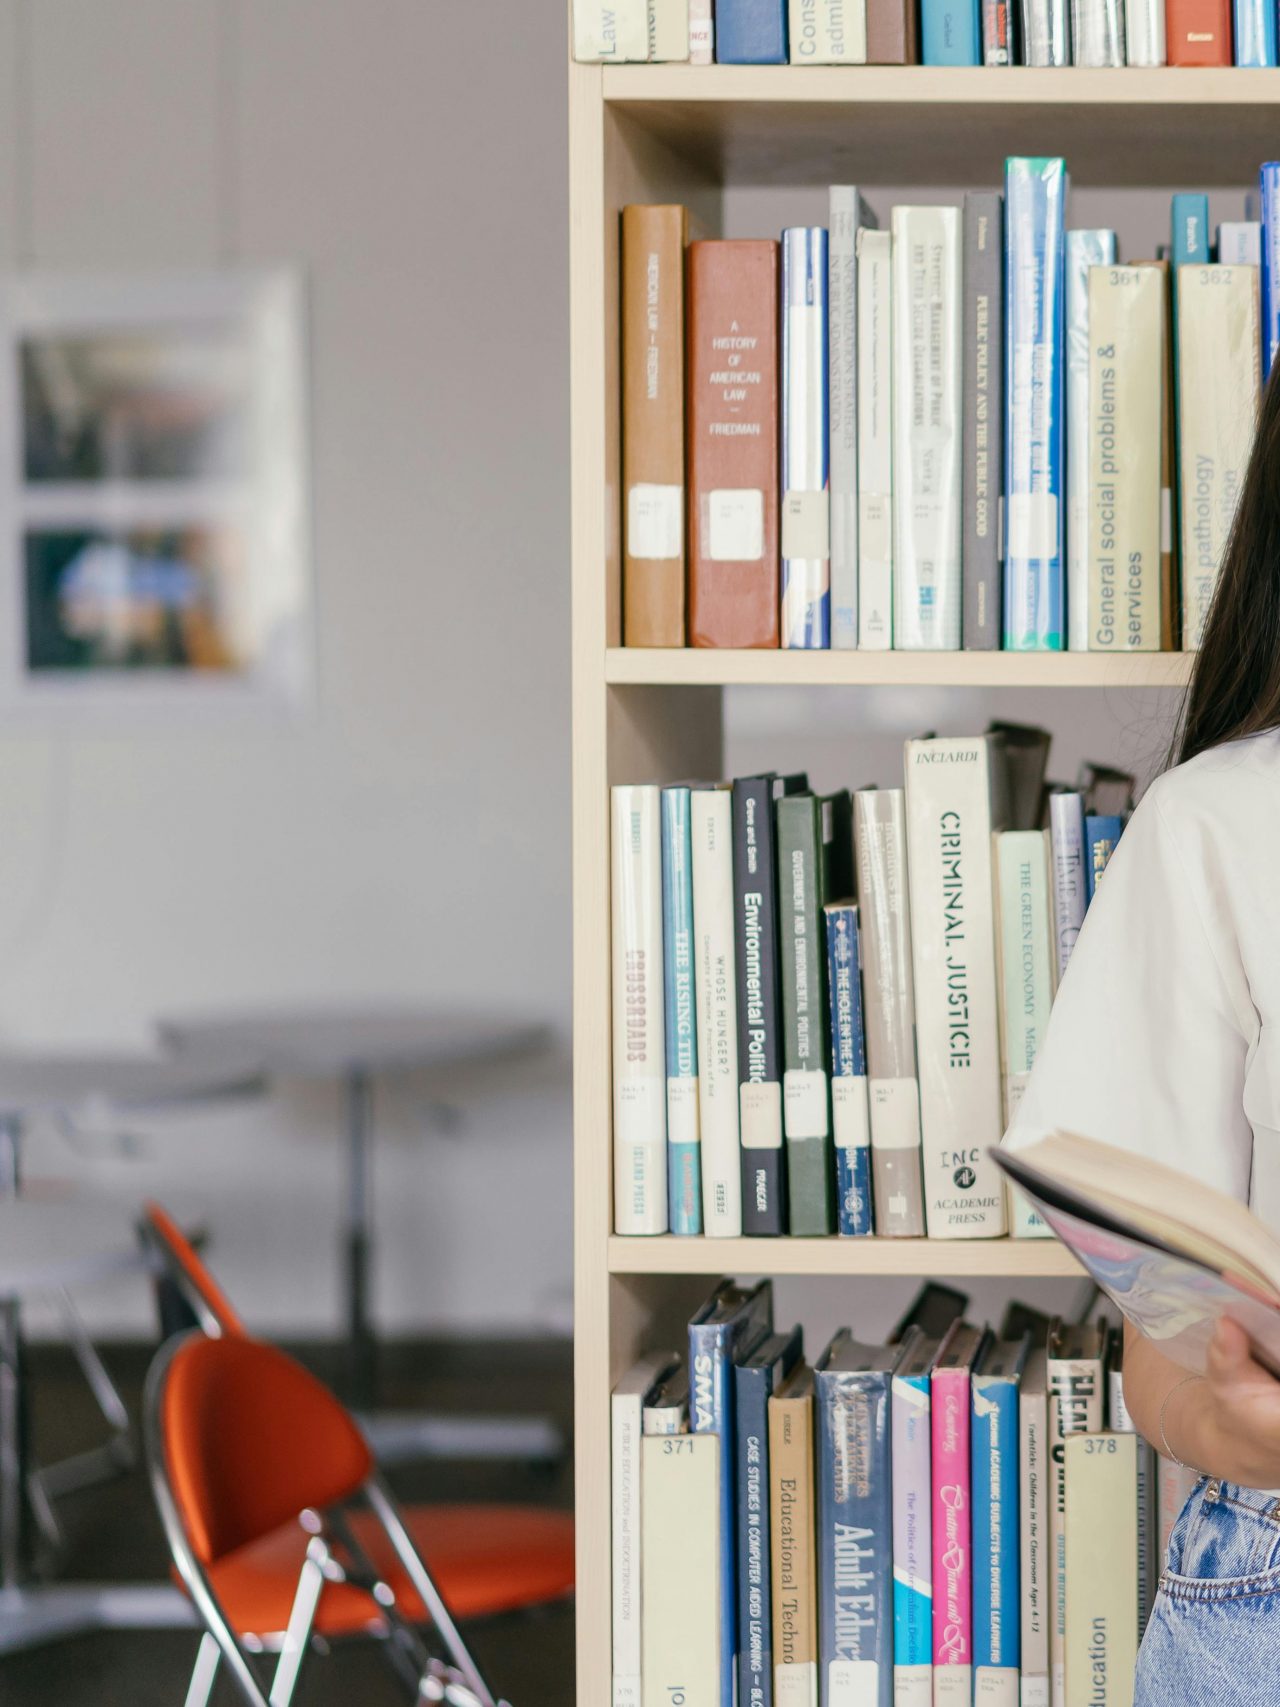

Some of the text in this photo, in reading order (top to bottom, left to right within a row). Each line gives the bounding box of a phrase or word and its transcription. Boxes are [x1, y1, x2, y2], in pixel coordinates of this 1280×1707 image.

[599, 9, 616, 56] Law
[1186, 216, 1198, 254] Branch
[830, 273, 841, 317] PUBLIC
[1109, 271, 1139, 286] 361
[1200, 270, 1232, 285] 362
[712, 337, 758, 350] HISTORY
[730, 319, 740, 332] A
[709, 371, 761, 384] AMERICAN
[727, 353, 742, 367] OF
[723, 389, 746, 401] LAW
[709, 423, 761, 435] FRIEDMAN
[976, 296, 989, 537] PUBLIC POLICY AND THE PUBLIC GOOD
[1096, 343, 1119, 645] General social problems &
[1193, 454, 1218, 568] pathology
[1125, 552, 1143, 646] services
[917, 751, 979, 764] INCIARDI
[747, 827, 757, 845] and
[747, 847, 758, 873] Smith
[860, 823, 873, 893] Protection
[744, 892, 765, 1024] Environmental
[792, 850, 810, 1058] GOVERNMENT AND ENVIRONMENTAL POLITICS
[940, 811, 971, 1068] CRIMINAL JUSTICE
[1020, 862, 1035, 1017] THE GREEN ECONOMY
[675, 928, 691, 1034] THE RISING
[626, 949, 646, 1062] CROSSROADS
[716, 956, 729, 1075] WHOSE HUNGER?
[756, 1168, 767, 1212] PRAEGER
[934, 1197, 1000, 1209] ACADEMIC
[948, 1213, 986, 1224] PRESS
[663, 1439, 694, 1454] 371
[1084, 1439, 1117, 1454] 378
[990, 1449, 1002, 1501] ACADEMIC
[1029, 1472, 1038, 1509] Children
[906, 1491, 917, 1511] The
[1030, 1510, 1038, 1521] in
[780, 1478, 799, 1590] Educational
[906, 1513, 917, 1552] Politics
[990, 1502, 1002, 1552] SUBJECTS
[1030, 1521, 1038, 1538] the
[748, 1435, 763, 1671] CASE STUDIES IN COMPUTER AIDED LEARNING
[834, 1522, 875, 1589] Adult
[907, 1553, 917, 1564] of
[1030, 1539, 1039, 1584] Classroom
[990, 1567, 1002, 1609] DIVERSE
[990, 1610, 1003, 1663] LEARNERS
